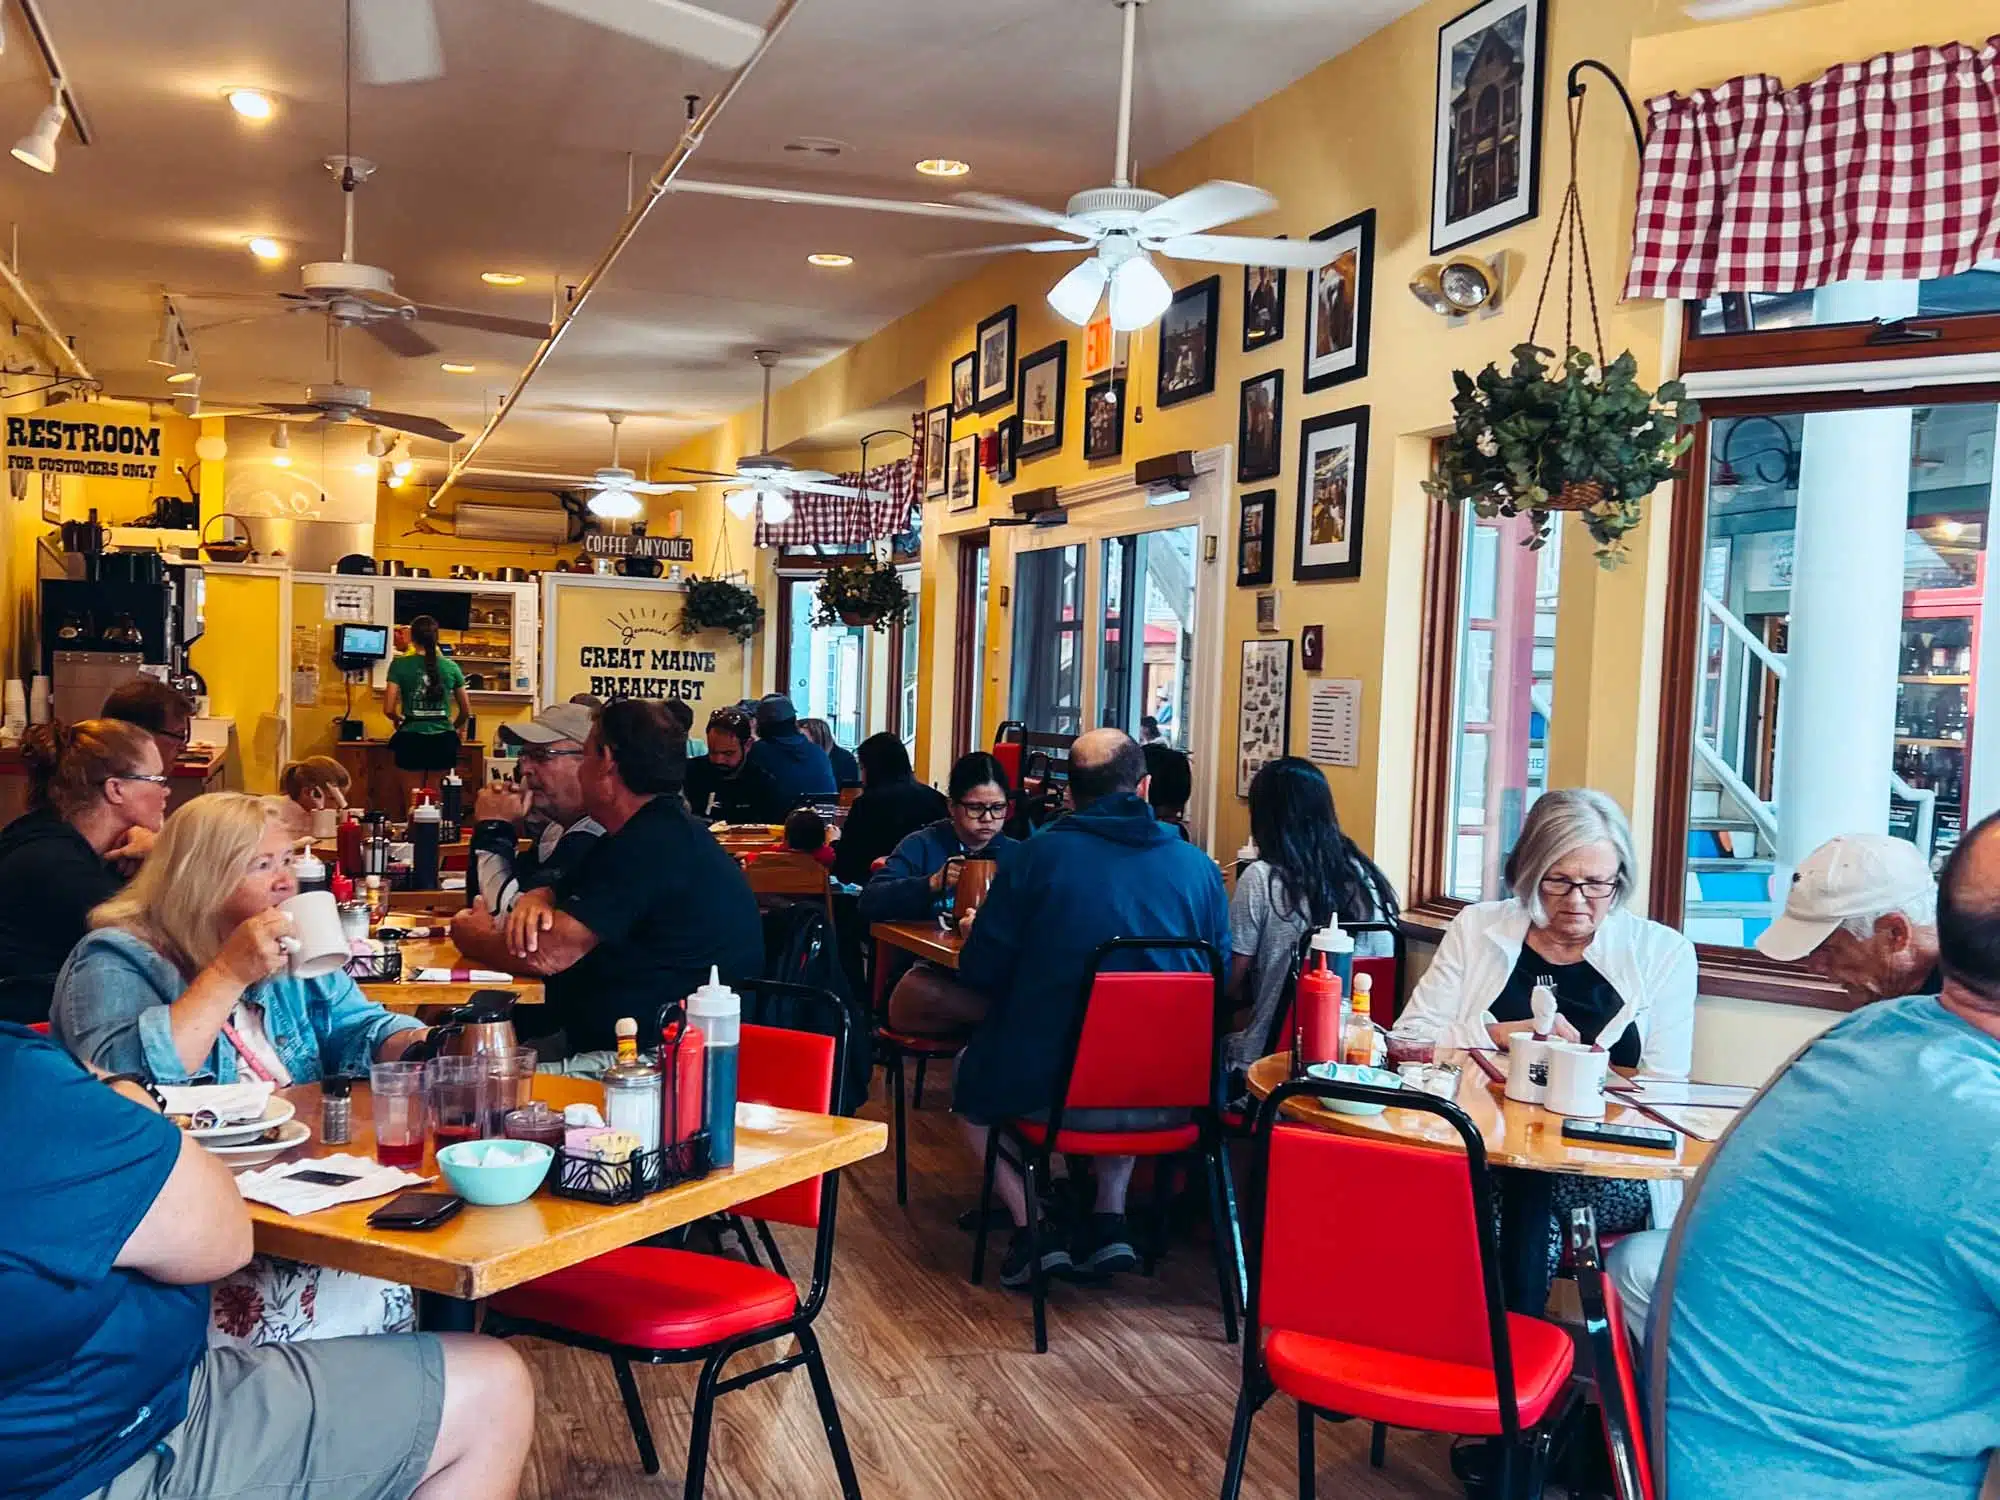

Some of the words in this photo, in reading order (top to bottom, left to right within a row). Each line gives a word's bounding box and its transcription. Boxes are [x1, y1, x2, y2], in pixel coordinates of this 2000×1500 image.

[7, 416, 160, 456] RESTROOM
[8, 454, 34, 470] FOR
[39, 457, 118, 476] CUSTOMERS
[122, 463, 157, 479] ONLY
[635, 539, 692, 558] ANYONE?
[580, 646, 645, 670] GREAT
[651, 649, 716, 672] MAINE
[590, 675, 705, 700] BREAKFAST
